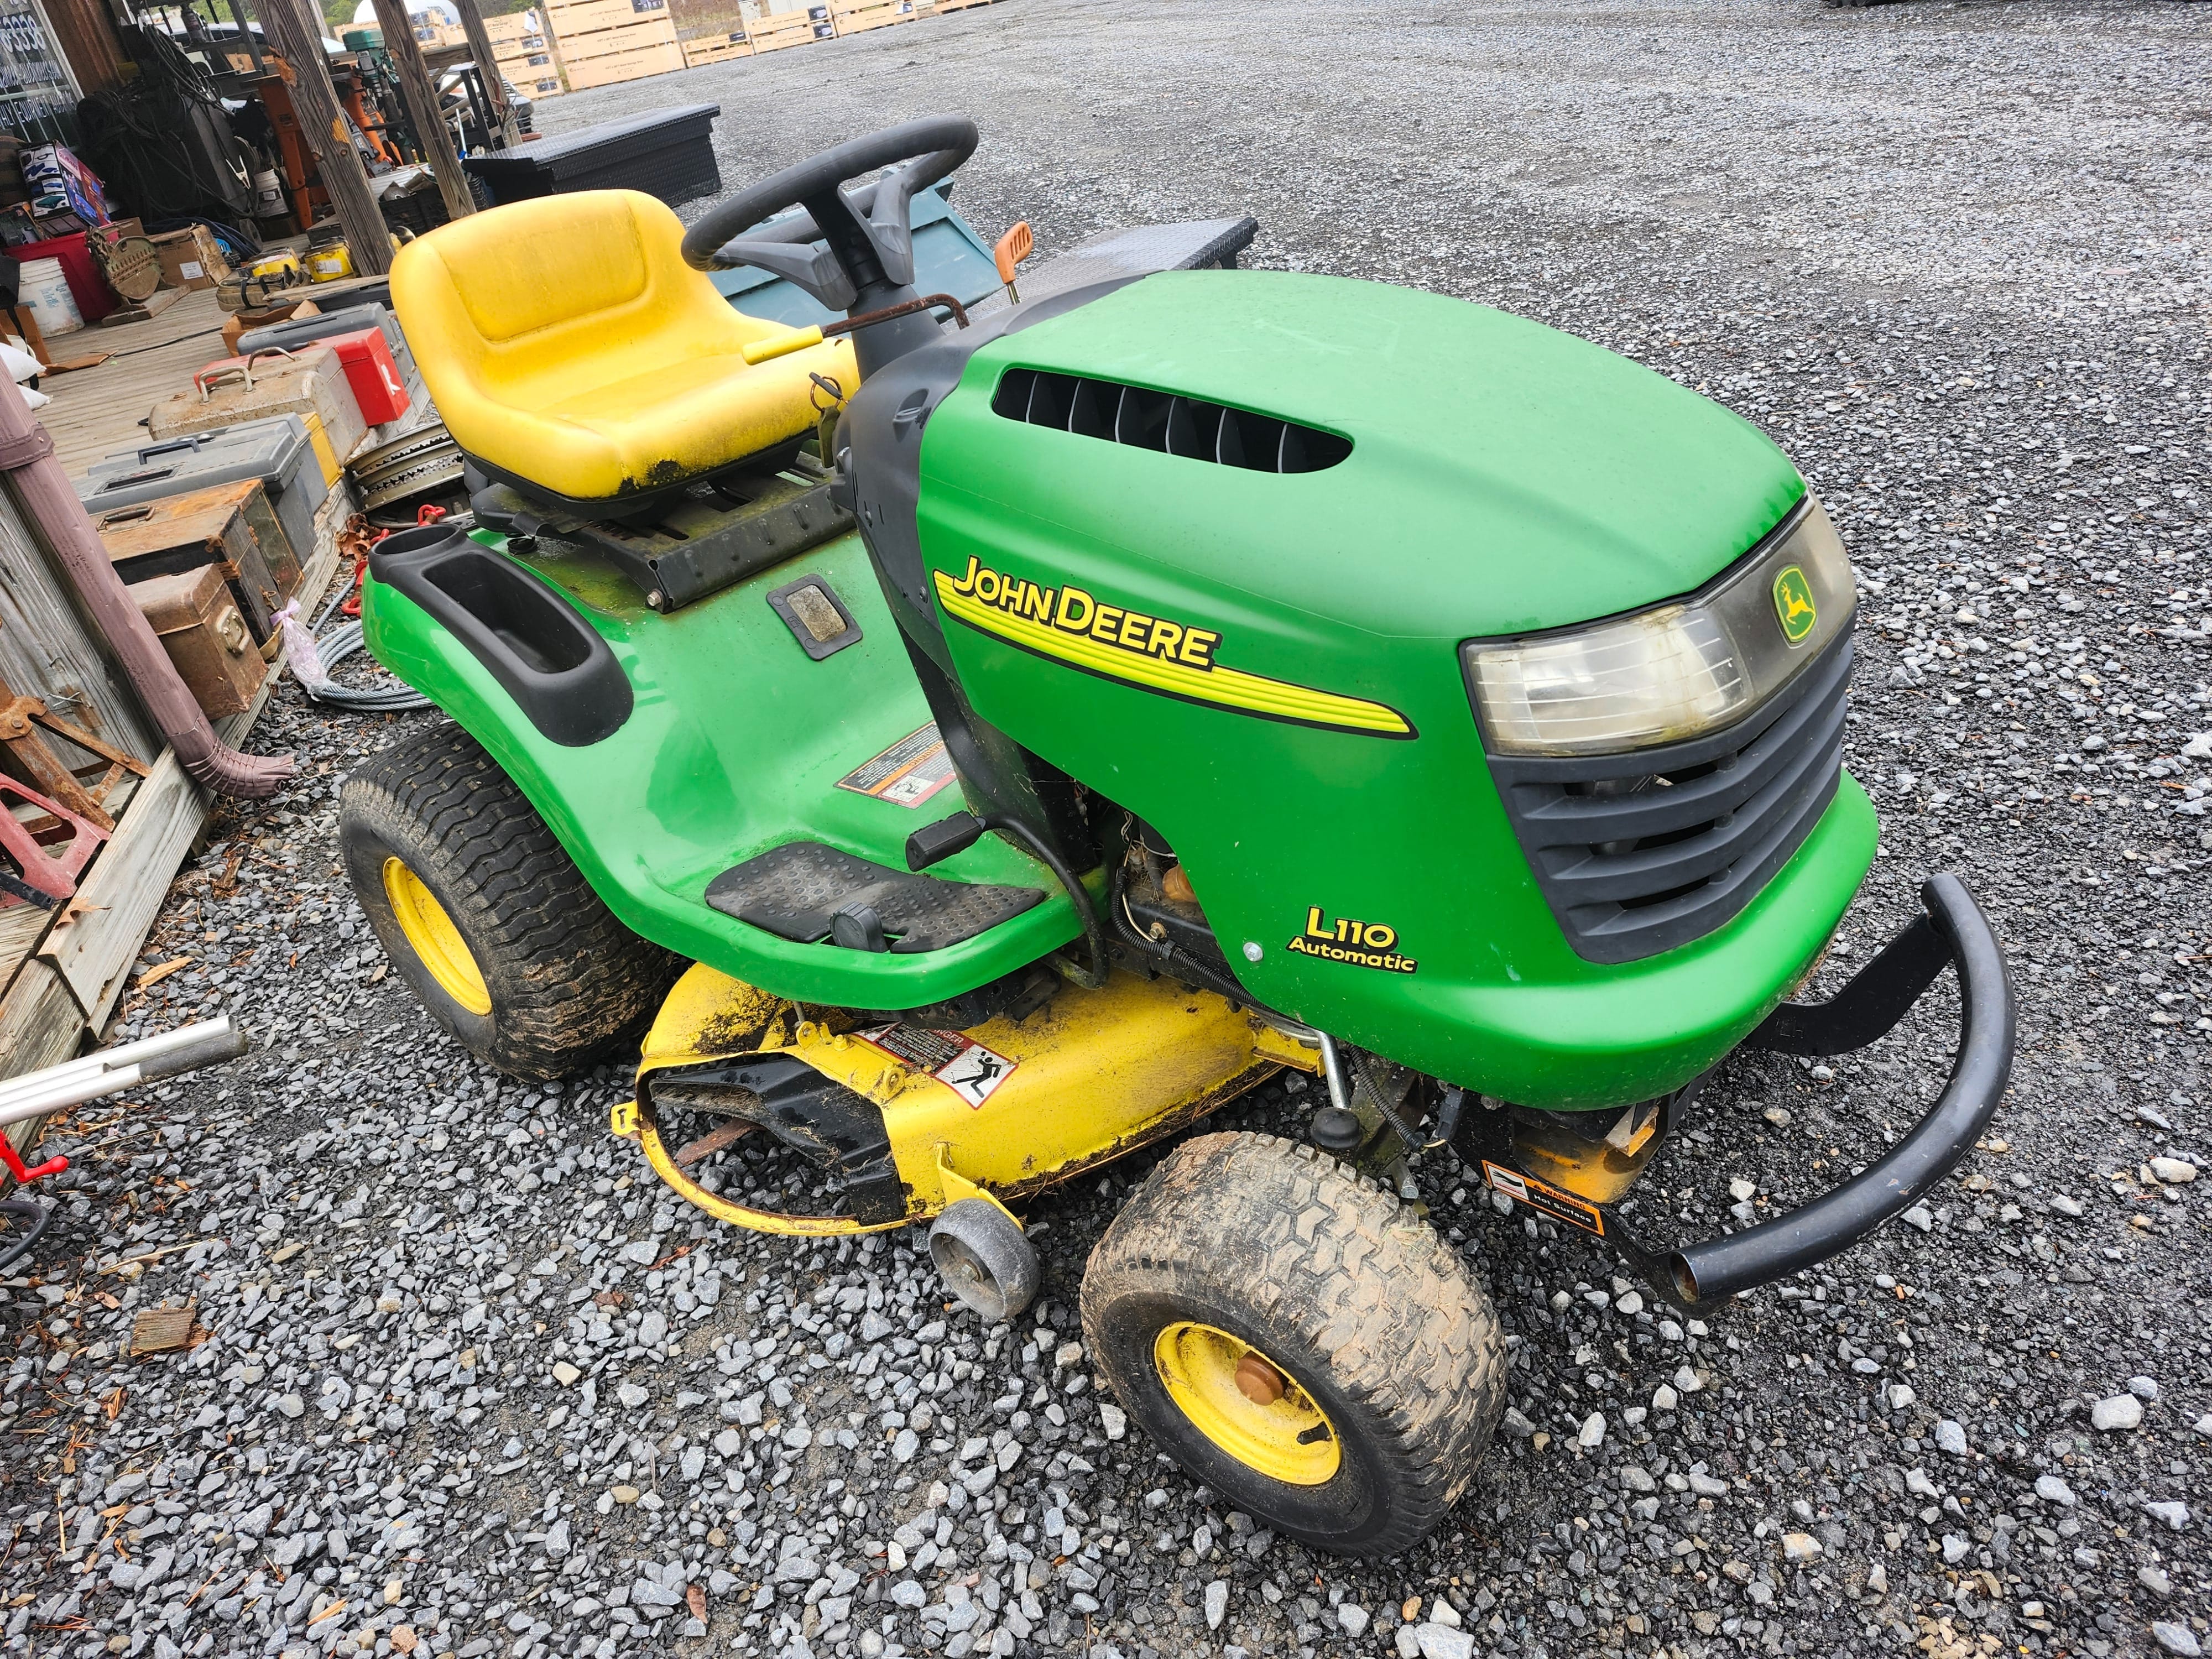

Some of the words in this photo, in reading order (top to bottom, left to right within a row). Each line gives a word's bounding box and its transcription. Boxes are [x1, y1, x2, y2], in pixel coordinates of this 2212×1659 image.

[14, 96, 51, 123] EQUIPMENT
[953, 556, 1054, 621] JOHN
[1056, 587, 1217, 667] DEERE
[1306, 907, 1395, 948] L110
[1288, 936, 1415, 972] Automatic
[1533, 1193, 1551, 1206] Hot
[1553, 1202, 1592, 1223] Surface
[1543, 1187, 1587, 1210] WARNING
